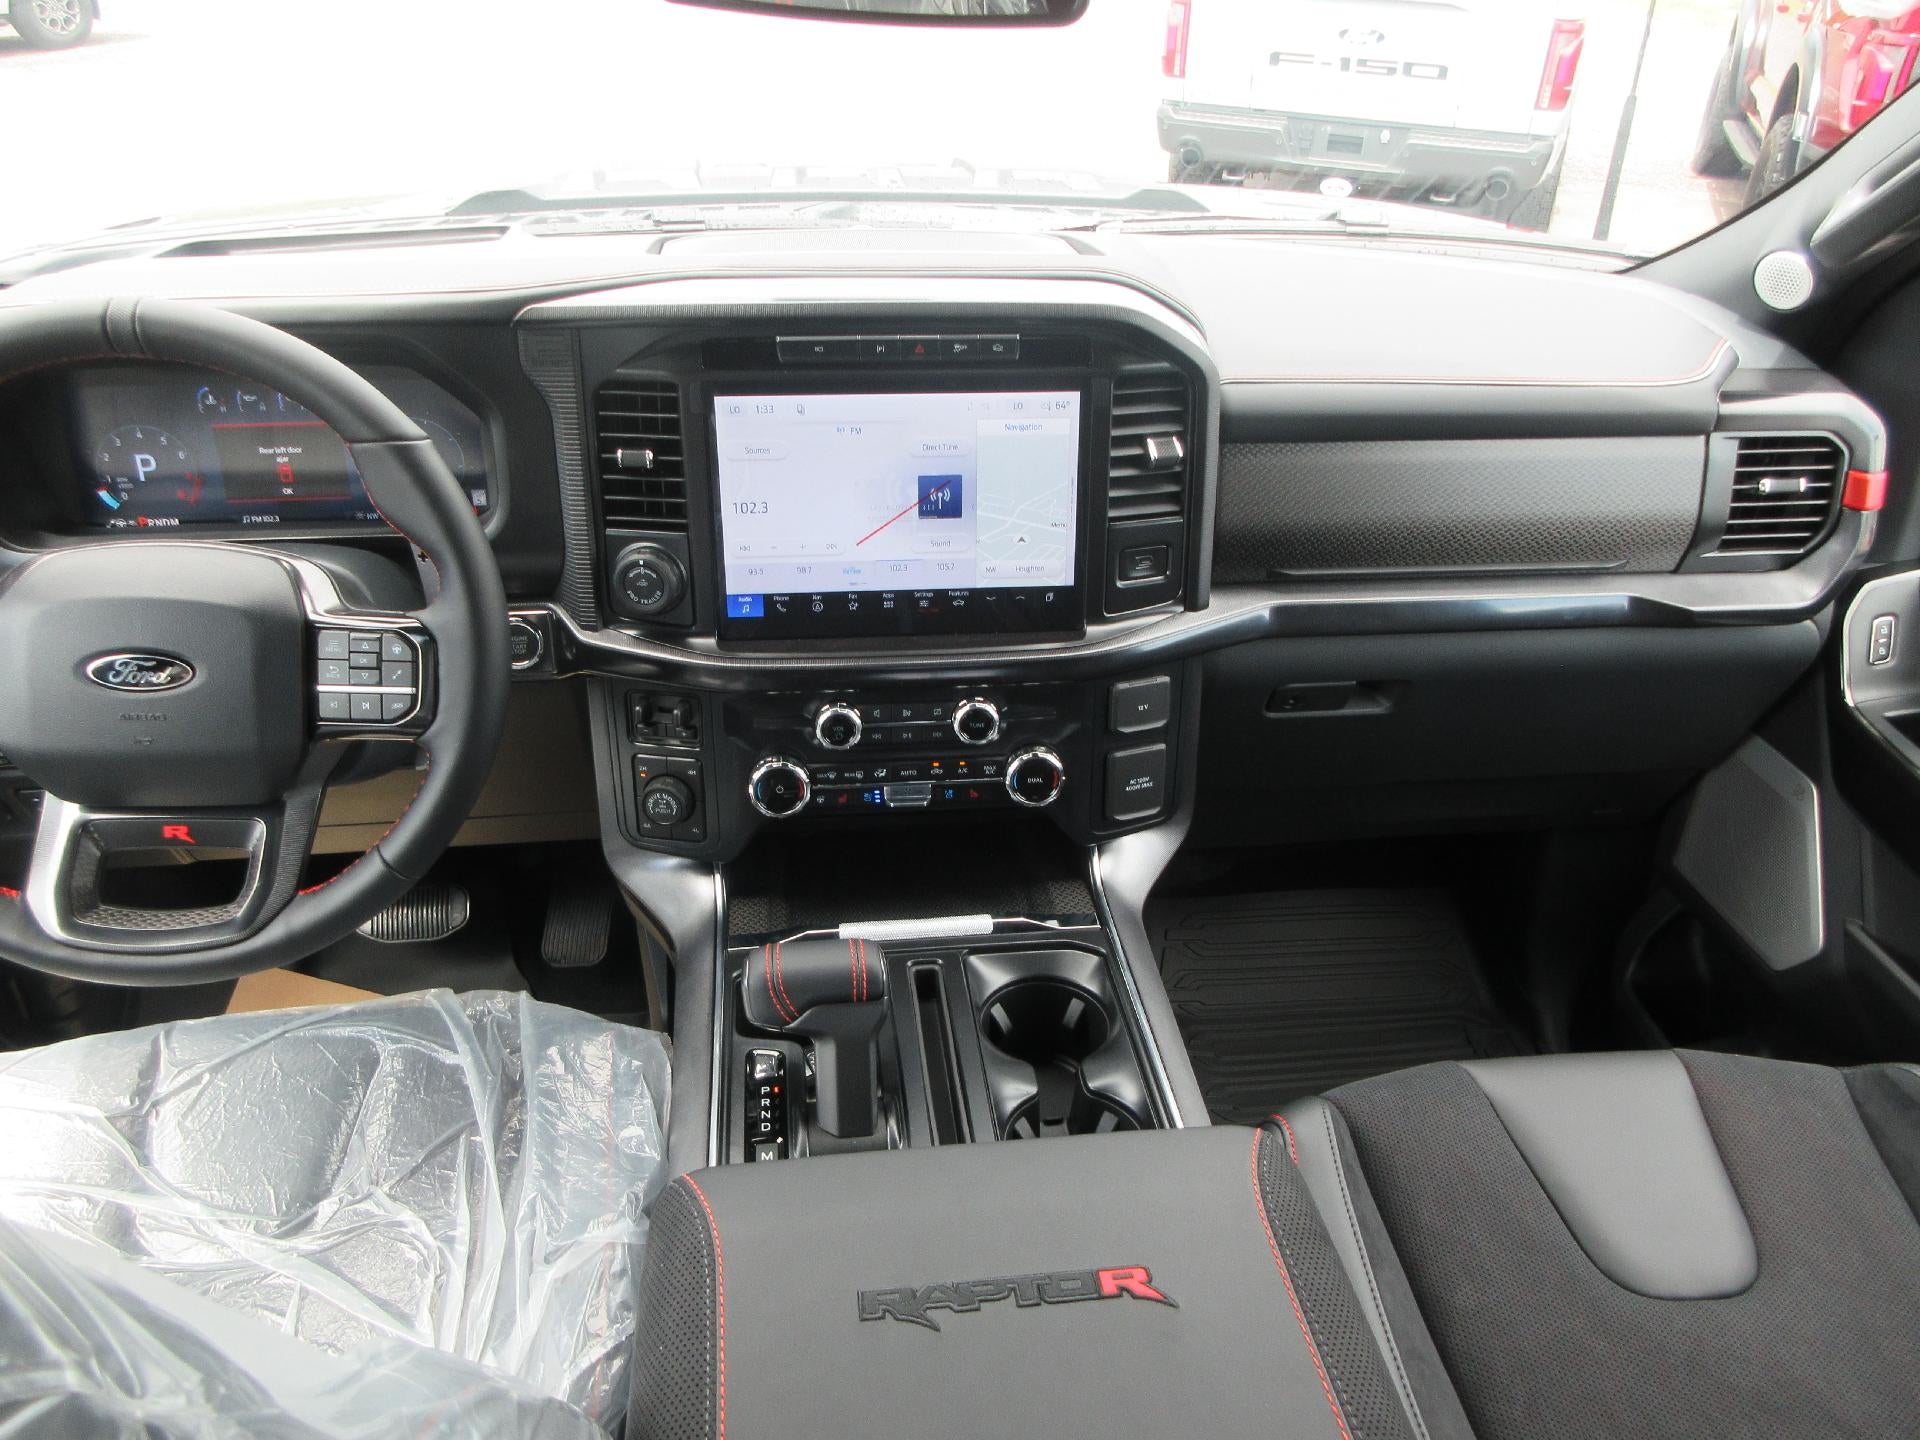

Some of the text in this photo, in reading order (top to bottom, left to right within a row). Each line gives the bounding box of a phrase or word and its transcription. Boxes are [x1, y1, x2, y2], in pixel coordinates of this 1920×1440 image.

[1269, 51, 1449, 80] F-150
[756, 405, 774, 414] 1:33
[1004, 423, 1043, 433] Navigation
[275, 446, 287, 454] left
[288, 446, 302, 454] door
[744, 446, 771, 455] Sources
[134, 453, 157, 481] P
[282, 487, 294, 495] OK
[733, 502, 769, 514] 102.3
[251, 515, 280, 523] FM 102.3
[930, 539, 950, 547] Sound
[889, 563, 908, 572] 102.3
[937, 562, 955, 571] 105.7
[627, 590, 662, 604] PRO TRAILER
[914, 590, 934, 599] Settings
[109, 659, 172, 684] Ford
[648, 793, 661, 807] DRIVE
[162, 825, 197, 844] R
[761, 1086, 771, 1095] P
[761, 1098, 771, 1107] R
[761, 1110, 771, 1119] N
[761, 1122, 771, 1131] D
[761, 1151, 774, 1161] M
[857, 1265, 1181, 1332] RAPTOR
